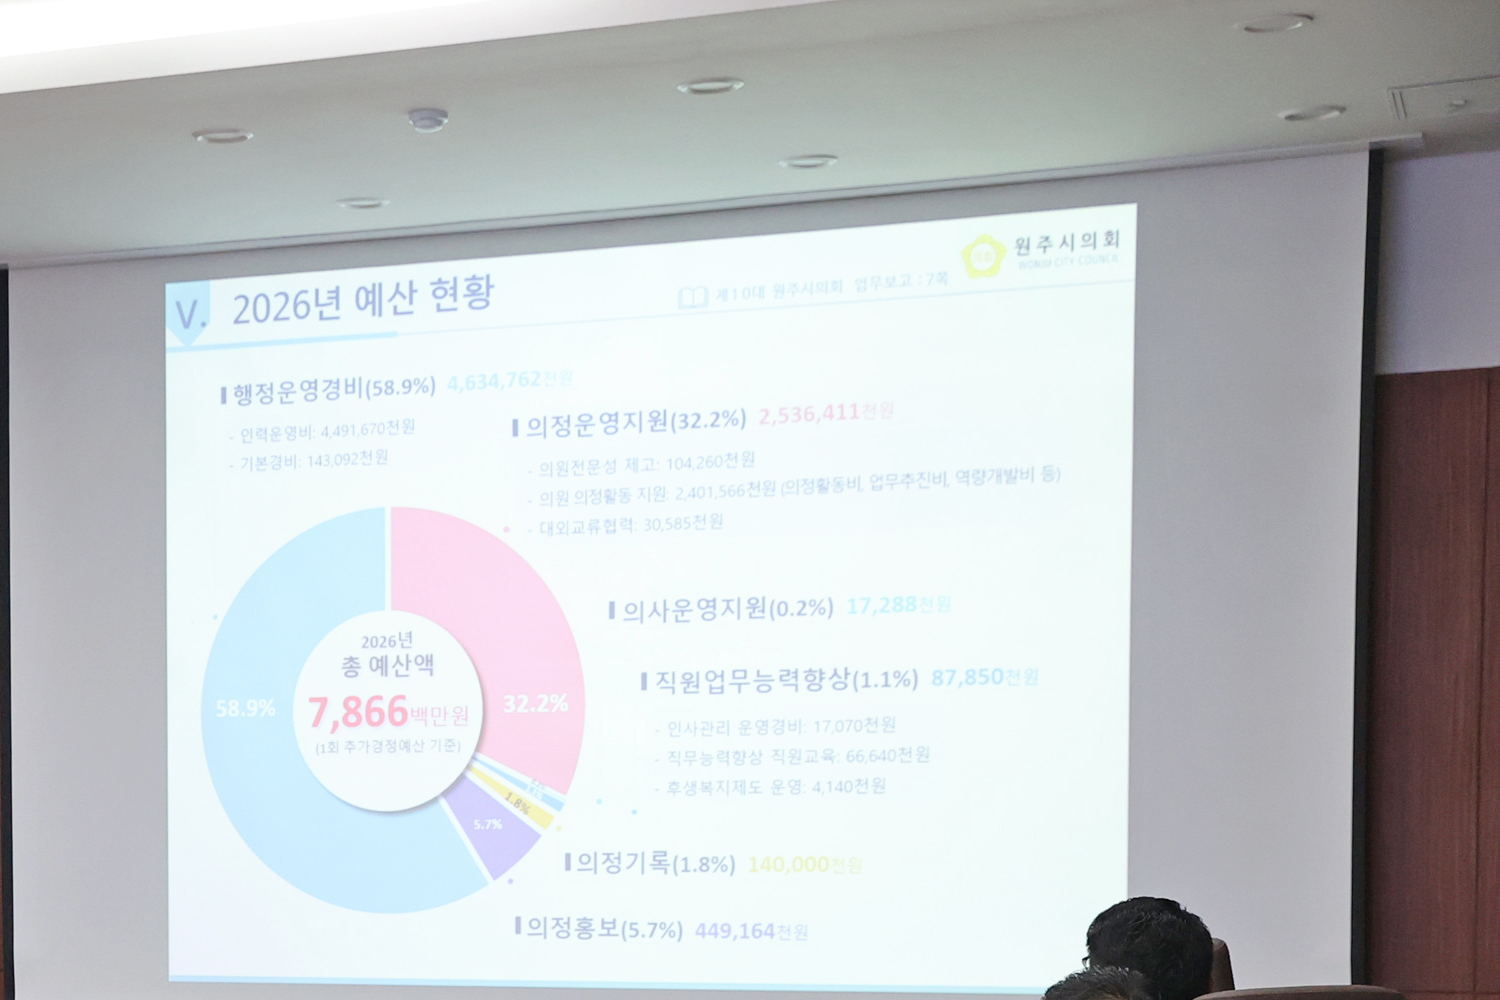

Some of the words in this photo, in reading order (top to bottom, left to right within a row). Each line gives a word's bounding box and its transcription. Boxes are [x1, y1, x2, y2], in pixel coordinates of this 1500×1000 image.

[1014, 228, 1120, 257] 원주시의회
[233, 285, 342, 326] 2026년
[355, 279, 418, 319] 예산
[429, 273, 496, 314] 현황
[714, 285, 766, 303] 제10대
[772, 278, 844, 300] 원주시의회
[855, 274, 913, 293] 업무보고
[233, 376, 436, 407] 행정운영경비(58.9%)
[526, 407, 747, 440] 의정운영지원(32.2%)
[759, 401, 895, 428] 2,536,411천원
[666, 450, 757, 472] 104,260천원
[675, 479, 777, 501] 2,401,566천원
[643, 513, 724, 533] 30,585천원
[622, 595, 835, 625] 의사운영지원(0.2%)
[846, 594, 953, 616] 17,288천원
[361, 631, 414, 650] 2026년
[341, 656, 363, 679] 총
[369, 653, 435, 678] 예산액
[655, 666, 919, 696] 직원업무능력향상(1.1%)
[931, 666, 1040, 689] 87,850천원
[216, 699, 276, 718] 58.9%
[308, 694, 470, 735] 7,866백만원
[503, 693, 570, 714] 32.2%
[667, 719, 731, 738] 인사관리
[813, 716, 897, 735] 17,070천원
[430, 738, 462, 754] 기준)
[667, 748, 764, 767] 직무능력향상
[846, 745, 931, 764] 66,640천원
[666, 778, 764, 797] 후생복지제도
[812, 777, 887, 796] 4,140천원
[505, 791, 531, 815] 1.8%
[474, 818, 503, 831] 5.7%
[576, 850, 737, 876] 의정기록(1.8%)
[748, 855, 863, 876] 140,000천원
[526, 916, 684, 943] 의정홍보(5.7%)
[695, 922, 809, 942] 449,164천원
